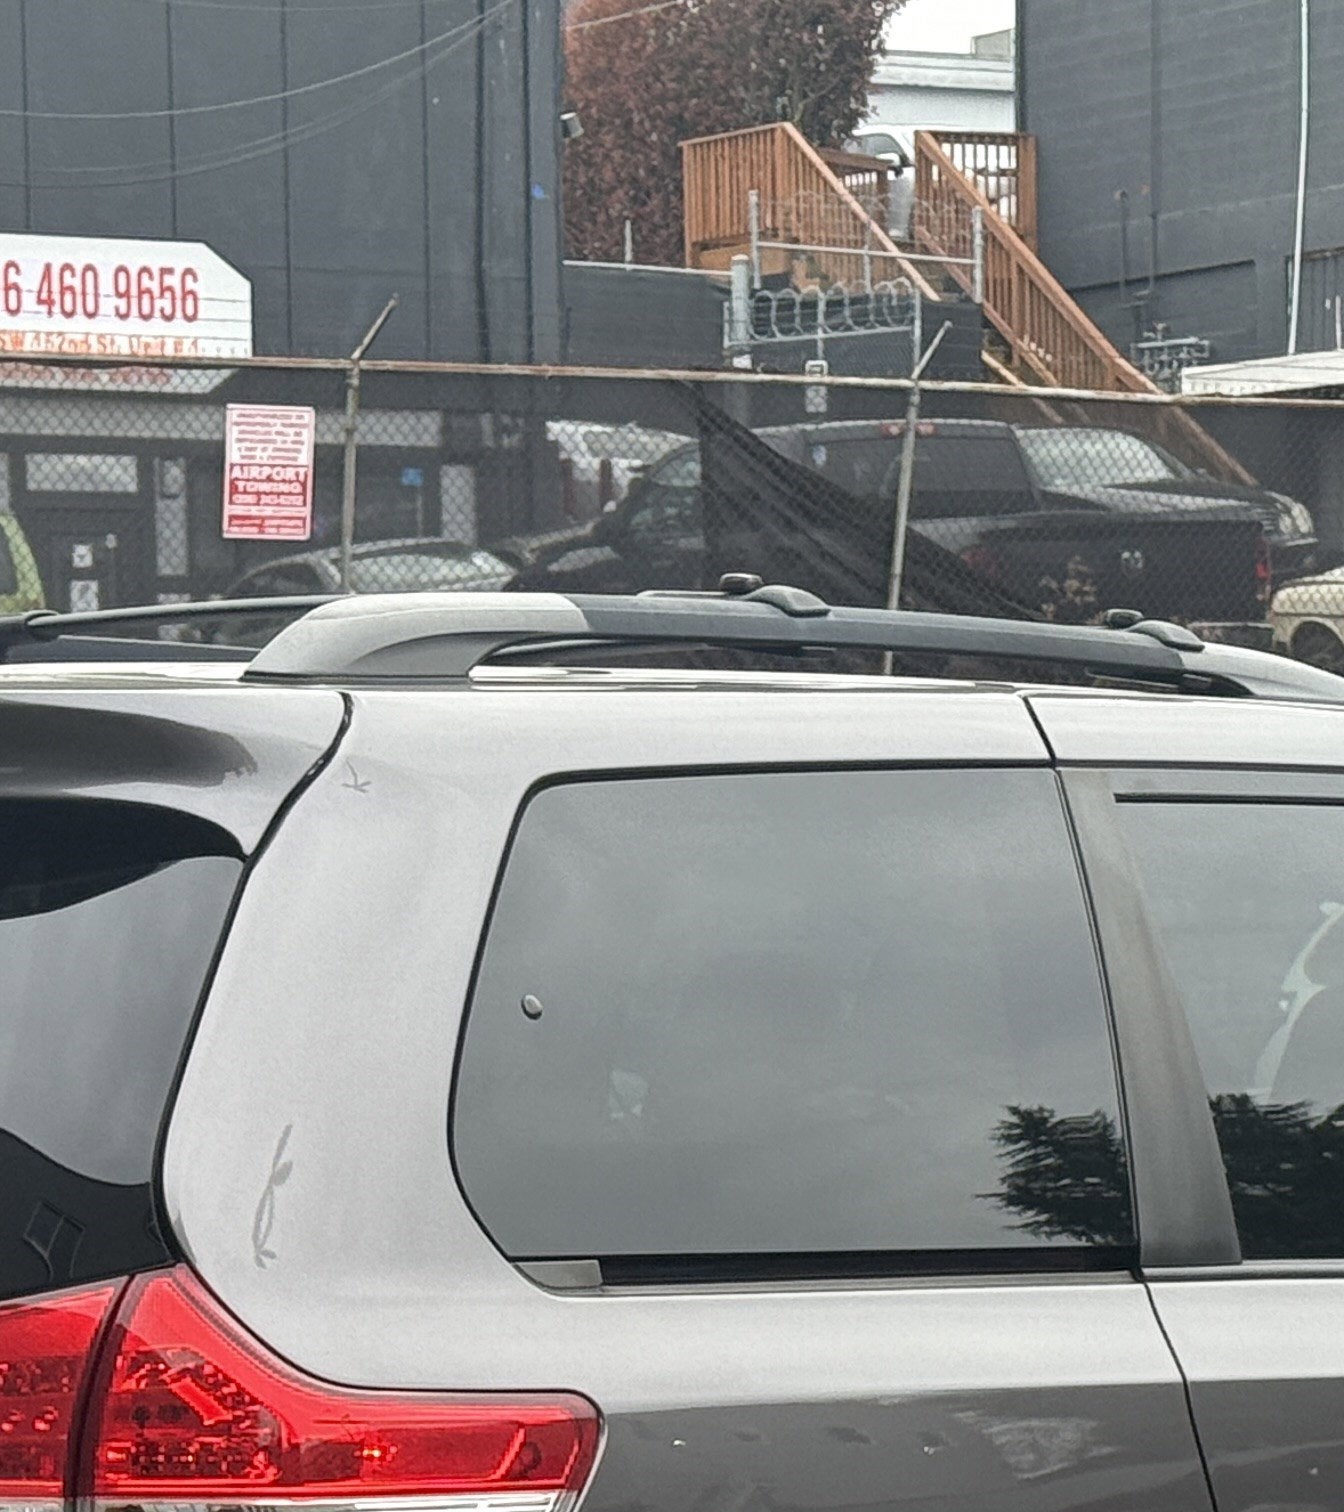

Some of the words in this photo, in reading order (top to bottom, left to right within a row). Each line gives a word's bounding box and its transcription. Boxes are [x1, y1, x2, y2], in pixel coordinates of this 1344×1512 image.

[36, 261, 100, 320] 460
[113, 264, 200, 323] 9656
[231, 465, 309, 482] AIRPORT
